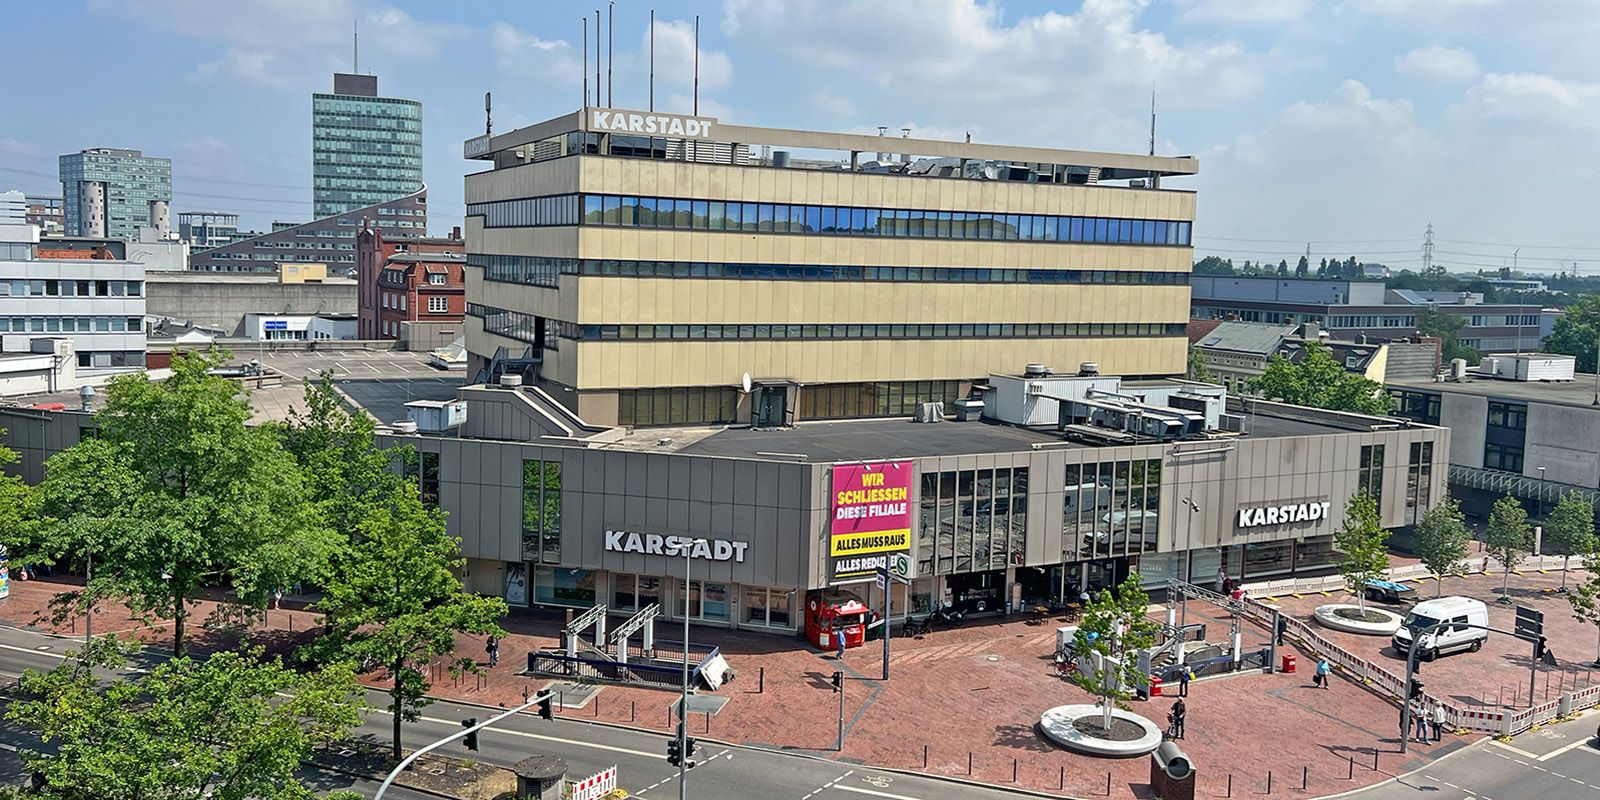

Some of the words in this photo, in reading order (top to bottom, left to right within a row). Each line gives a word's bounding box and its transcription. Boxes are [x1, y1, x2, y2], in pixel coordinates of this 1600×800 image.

[593, 111, 711, 137] KARSTADT
[862, 473, 884, 487] WIR
[837, 487, 907, 505] SCHLIESSEN
[836, 505, 867, 520] DIESE
[868, 503, 907, 517] FILIALE
[1239, 502, 1330, 527] KARSTADT
[605, 530, 747, 562] KARSTADT
[836, 538, 861, 551] ALLES
[861, 536, 884, 549] MUSS
[884, 534, 906, 547] RAUS
[835, 558, 861, 573] ALLES
[898, 558, 907, 575] S
